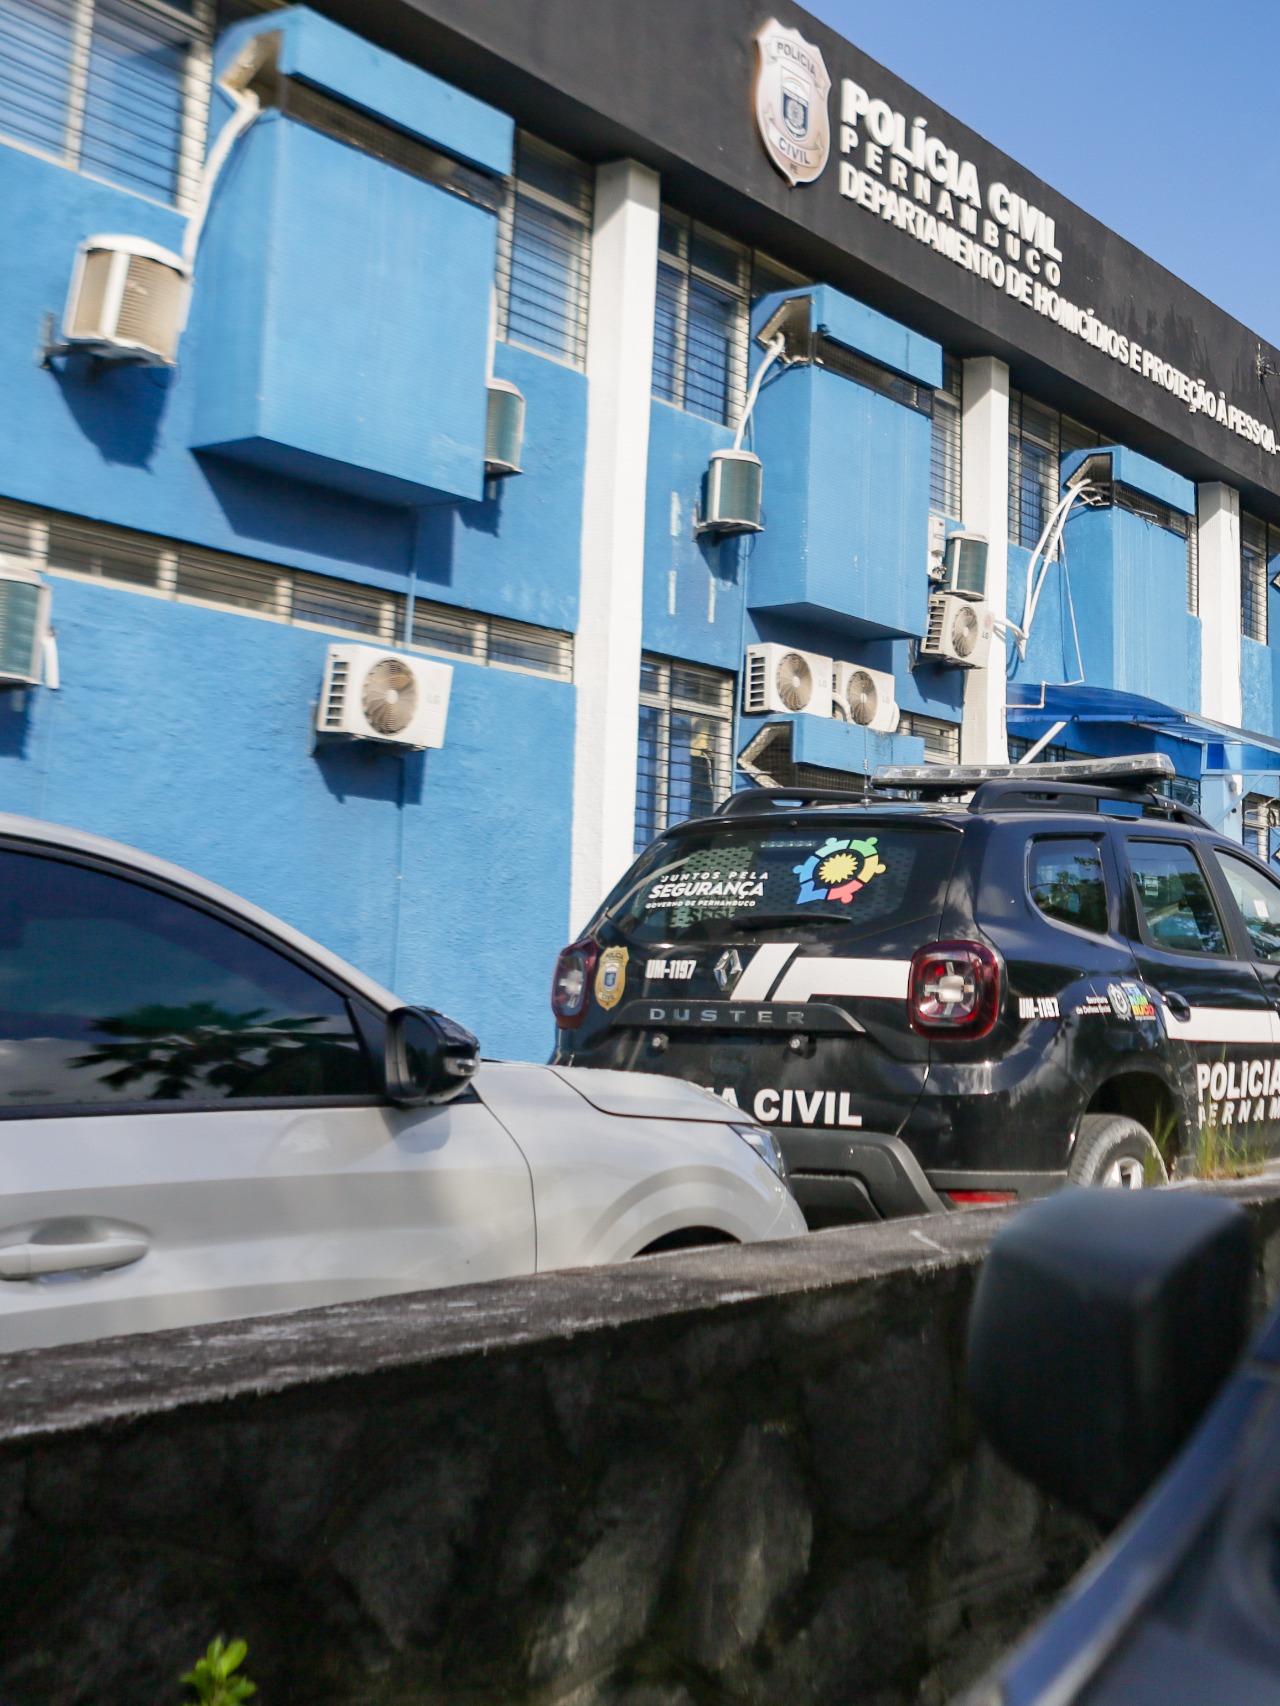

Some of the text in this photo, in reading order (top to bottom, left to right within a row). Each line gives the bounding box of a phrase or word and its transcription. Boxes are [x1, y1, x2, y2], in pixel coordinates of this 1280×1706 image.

[779, 137, 811, 165] CIVIL
[841, 78, 1063, 263] POLÍCIA CIVIL
[840, 125, 1061, 287] PERNAMBUCO
[839, 160, 1005, 288] DEPARTAMENTO
[1005, 264, 1034, 308] DE
[1033, 281, 1130, 365] HOMICÍDIOS
[1129, 341, 1143, 374] E
[1142, 349, 1217, 414] PROTEÇÃO
[661, 871, 769, 883] JUNTOS PELA
[648, 881, 764, 900] SEGURANÇA
[645, 901, 684, 909] GOVERNO
[645, 959, 697, 980] UM-1197
[649, 1008, 805, 1024] DUSTER
[753, 1088, 863, 1126] CIVIL
